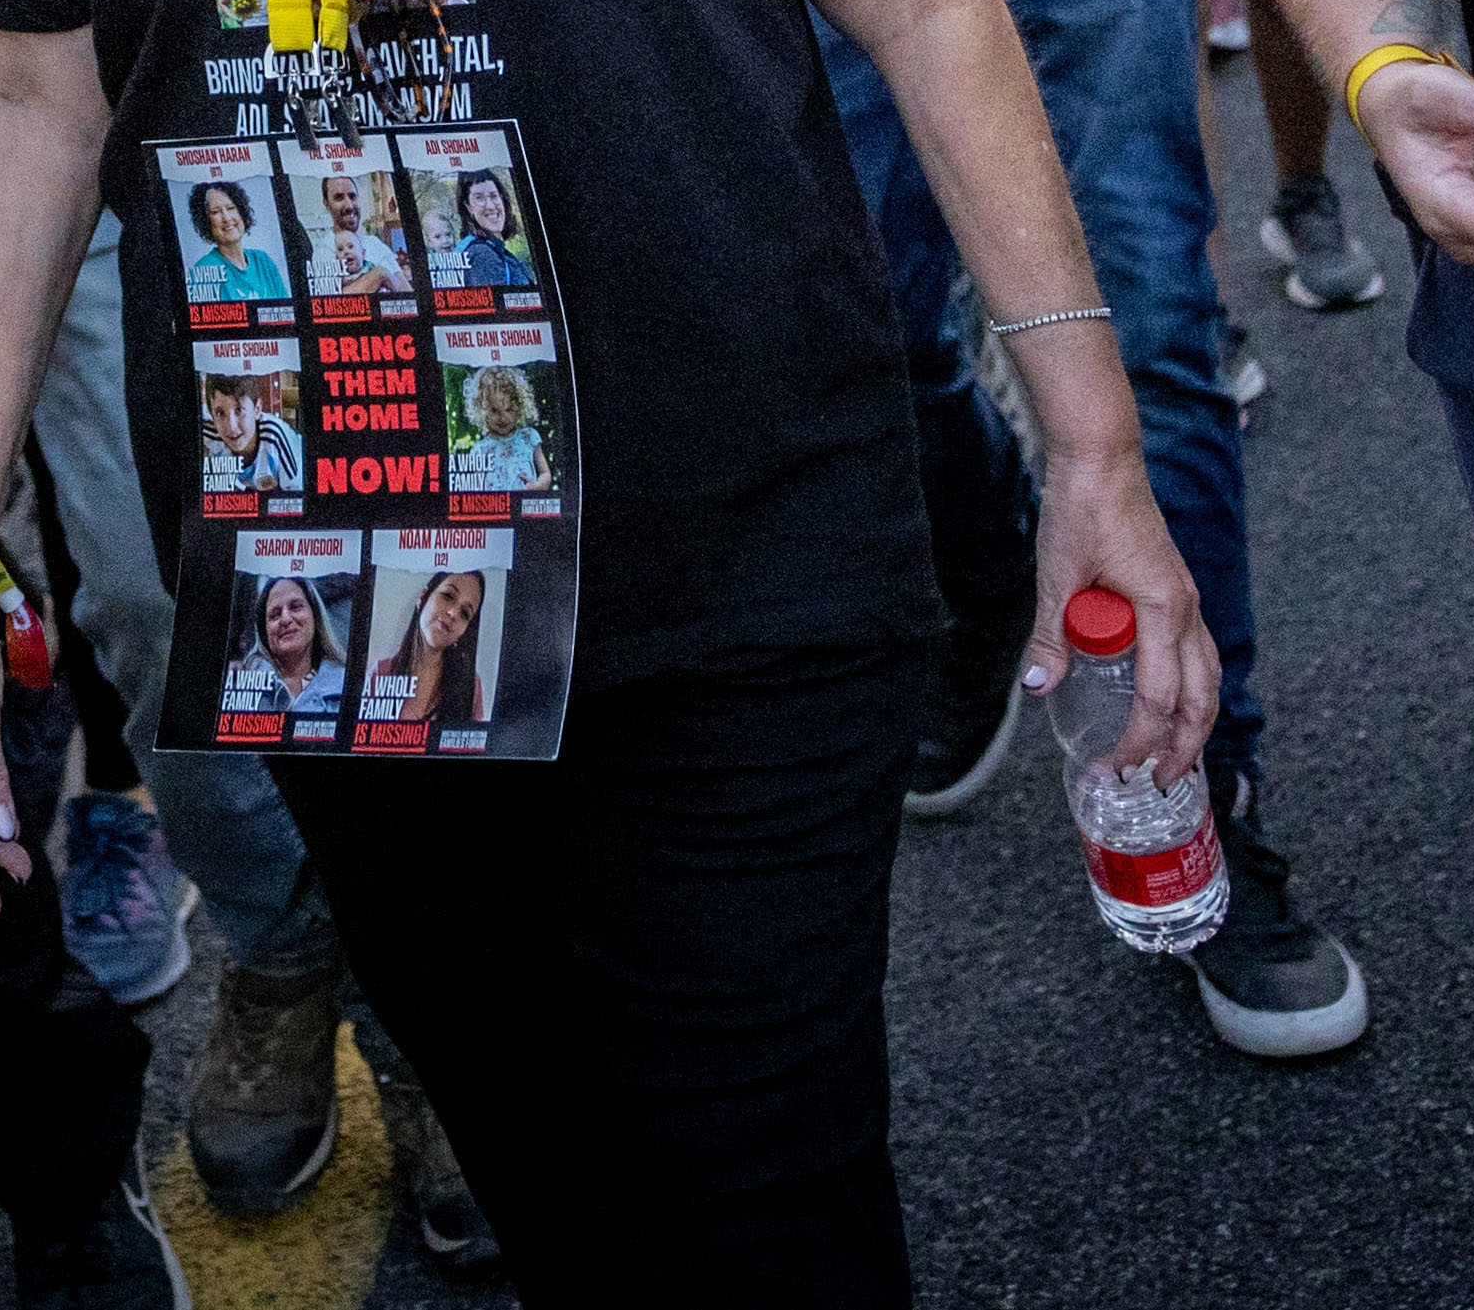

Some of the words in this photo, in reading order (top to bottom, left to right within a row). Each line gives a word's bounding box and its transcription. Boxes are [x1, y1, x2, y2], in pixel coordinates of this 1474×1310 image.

[204, 56, 266, 95] BRING
[175, 147, 218, 167] SHOSHAN
[219, 144, 252, 164] HARAN
[242, 341, 280, 357] SHOHAM
[318, 333, 418, 364] BRING
[445, 329, 474, 348] YAHEL
[500, 329, 543, 346] SHOHAM
[323, 368, 417, 398] THEM
[321, 403, 421, 432] HOME
[315, 453, 441, 495] NOW!
[254, 539, 295, 557] SHARON
[296, 537, 344, 557] AVIGDORI
[398, 530, 432, 550] NOAM
[434, 530, 488, 550] AVIGDORI
[235, 670, 275, 691] WHOLE
[374, 675, 419, 698] WHOLE
[222, 690, 263, 712] FAMILY
[358, 697, 405, 721] FAMILY
[232, 712, 286, 734] MISSING!
[369, 720, 431, 746] MISSING!
